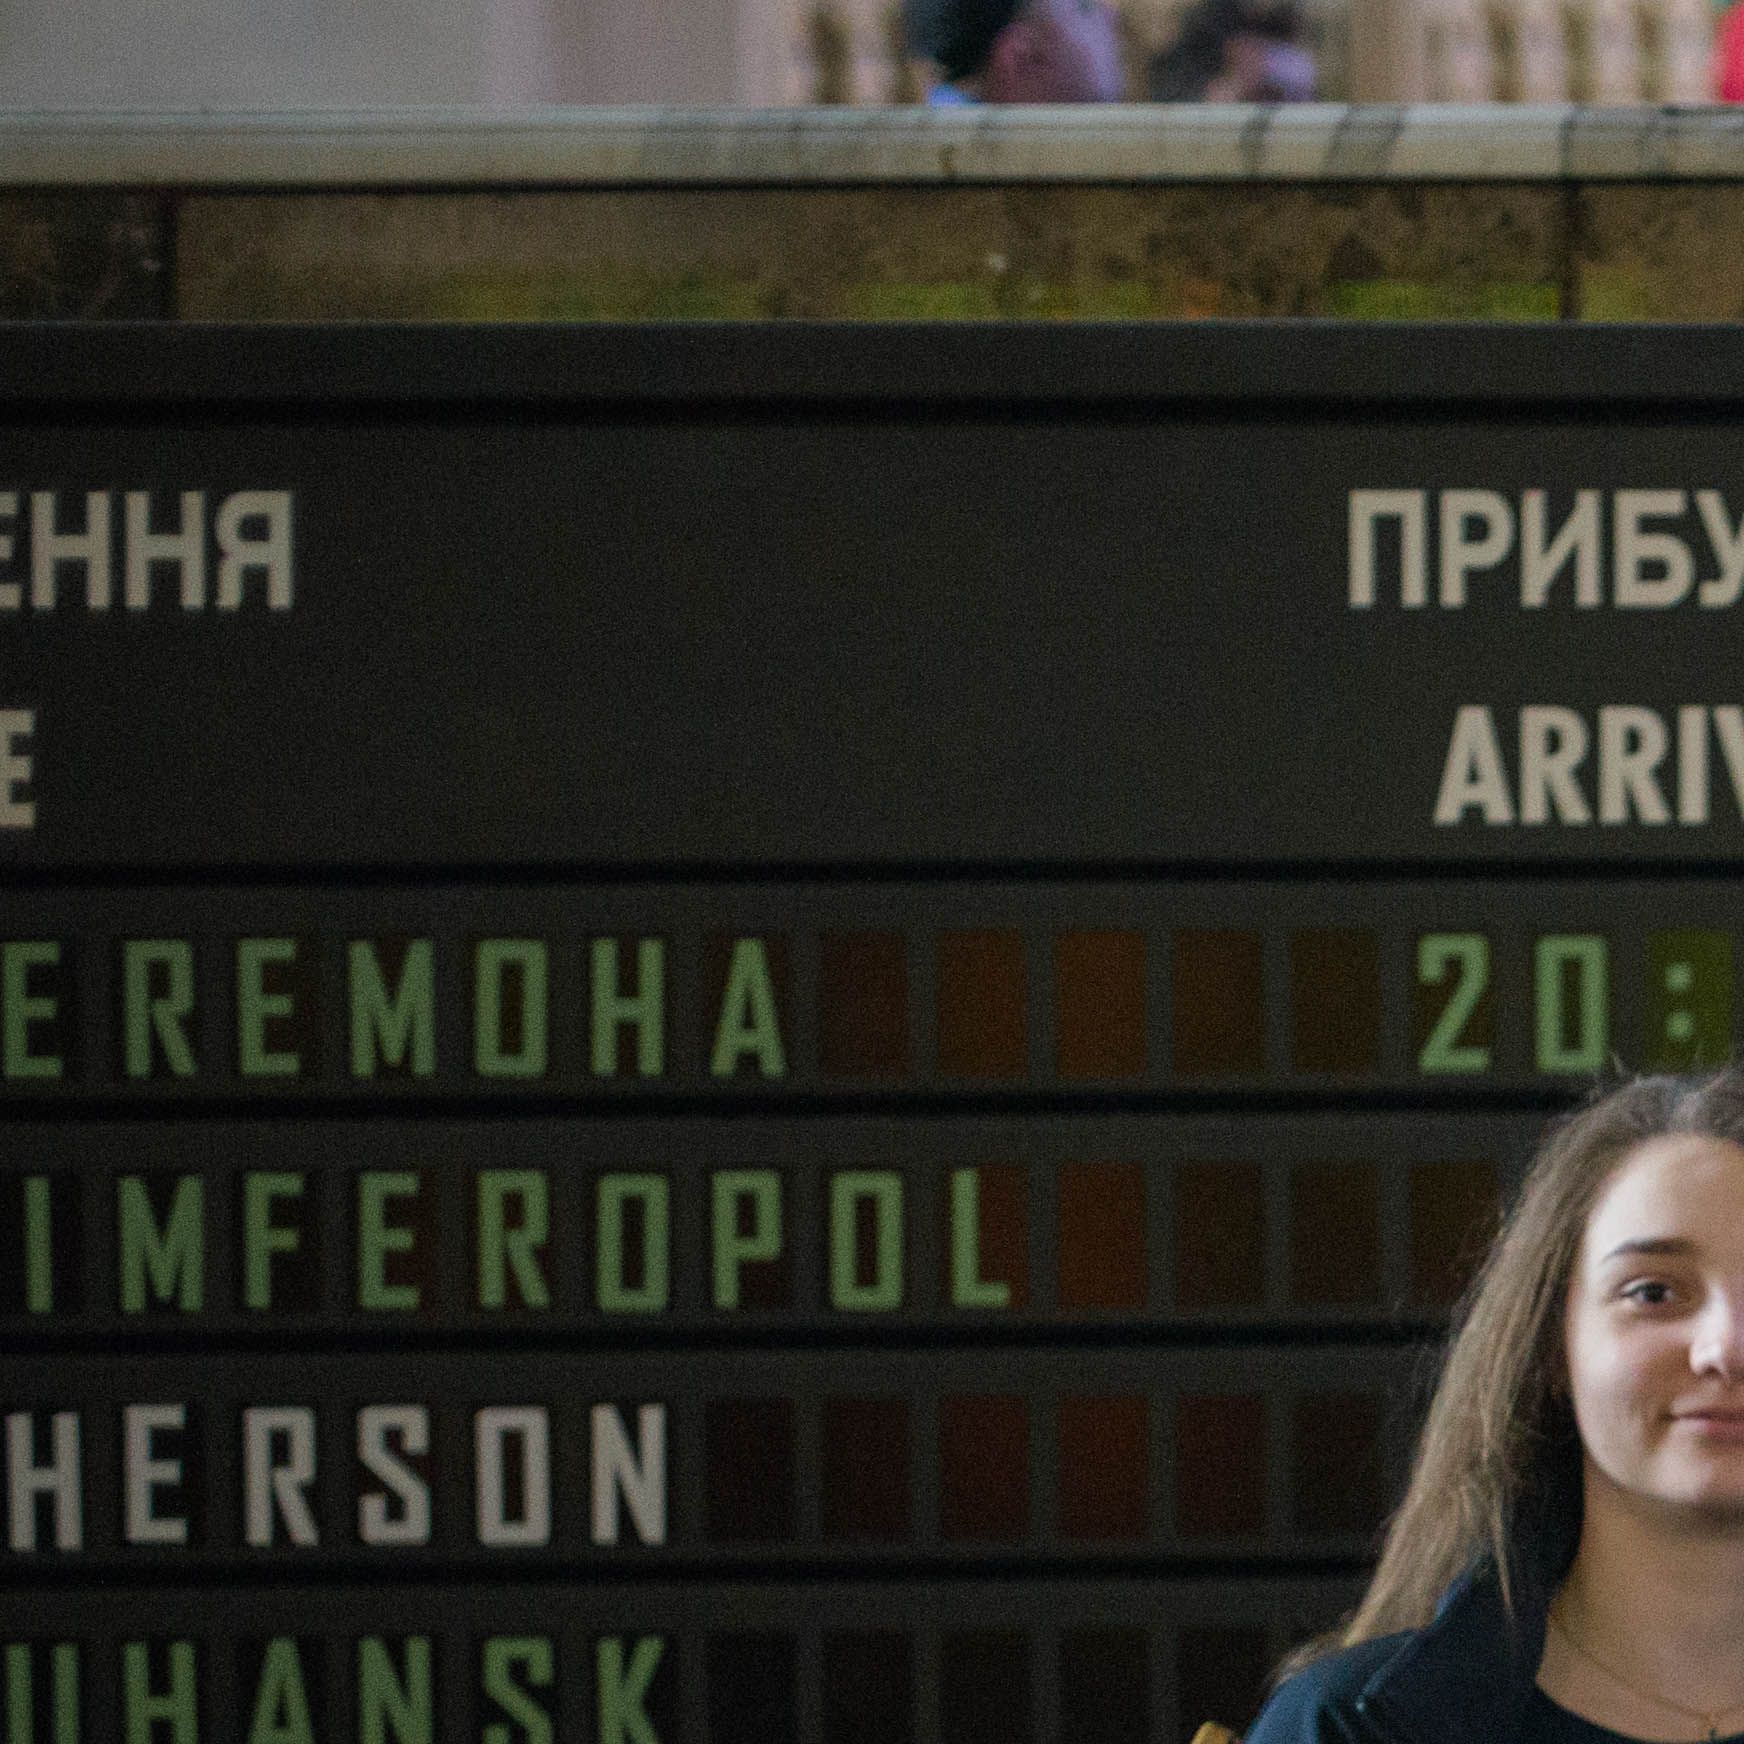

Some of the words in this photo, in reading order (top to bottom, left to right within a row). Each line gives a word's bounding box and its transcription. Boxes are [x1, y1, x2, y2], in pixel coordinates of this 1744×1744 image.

[0, 489, 294, 611] ННЯ
[3, 938, 786, 1078] EREMOHA
[25, 1168, 1010, 1314] IMFEROPOL
[5, 1403, 668, 1552] HERSON
